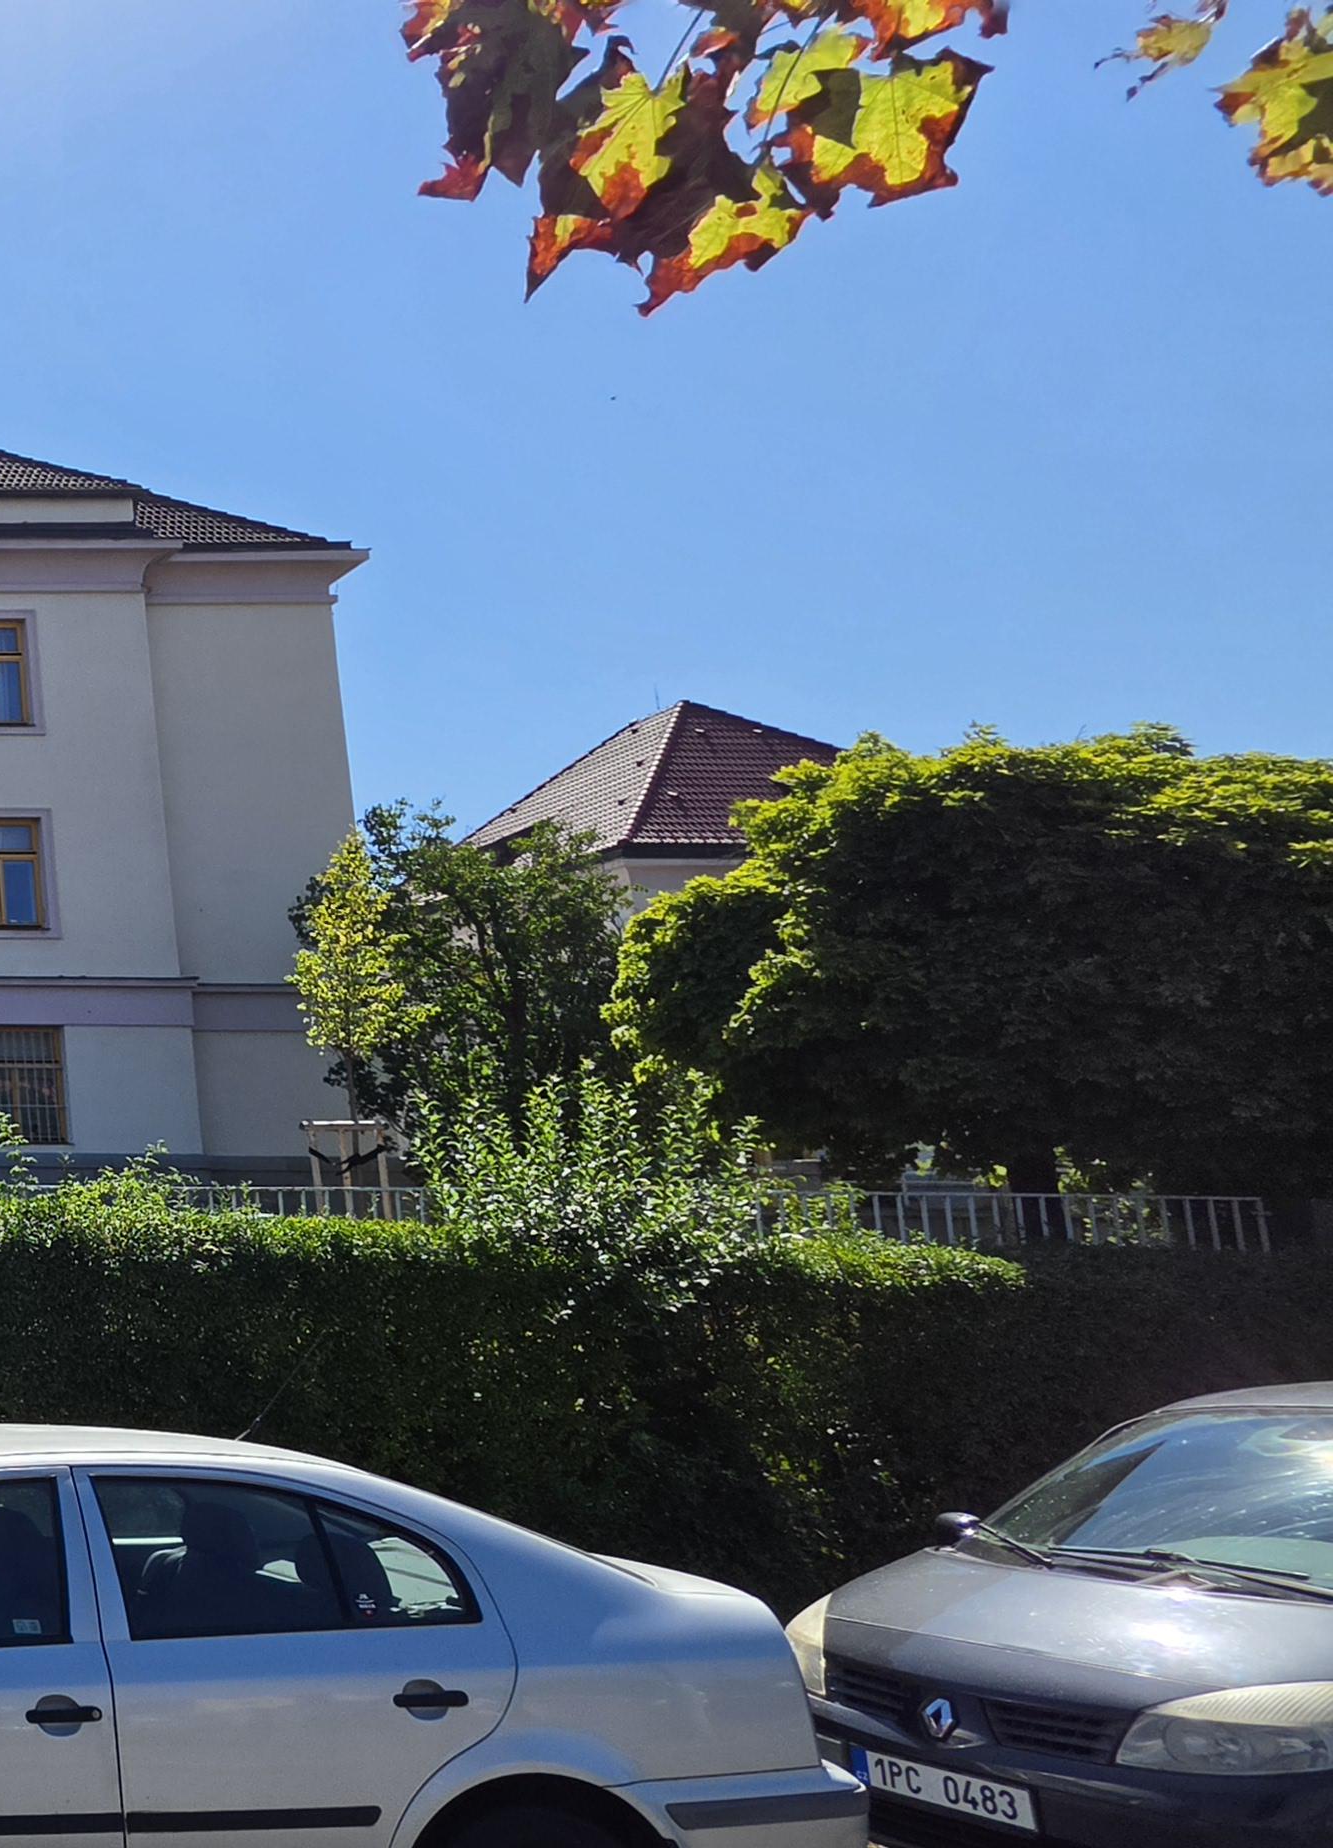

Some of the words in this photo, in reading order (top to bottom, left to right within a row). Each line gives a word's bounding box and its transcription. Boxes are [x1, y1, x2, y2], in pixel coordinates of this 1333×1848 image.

[856, 1770, 868, 1781] CZ
[874, 1757, 922, 1795] 1PC
[943, 1775, 1018, 1821] 0483
